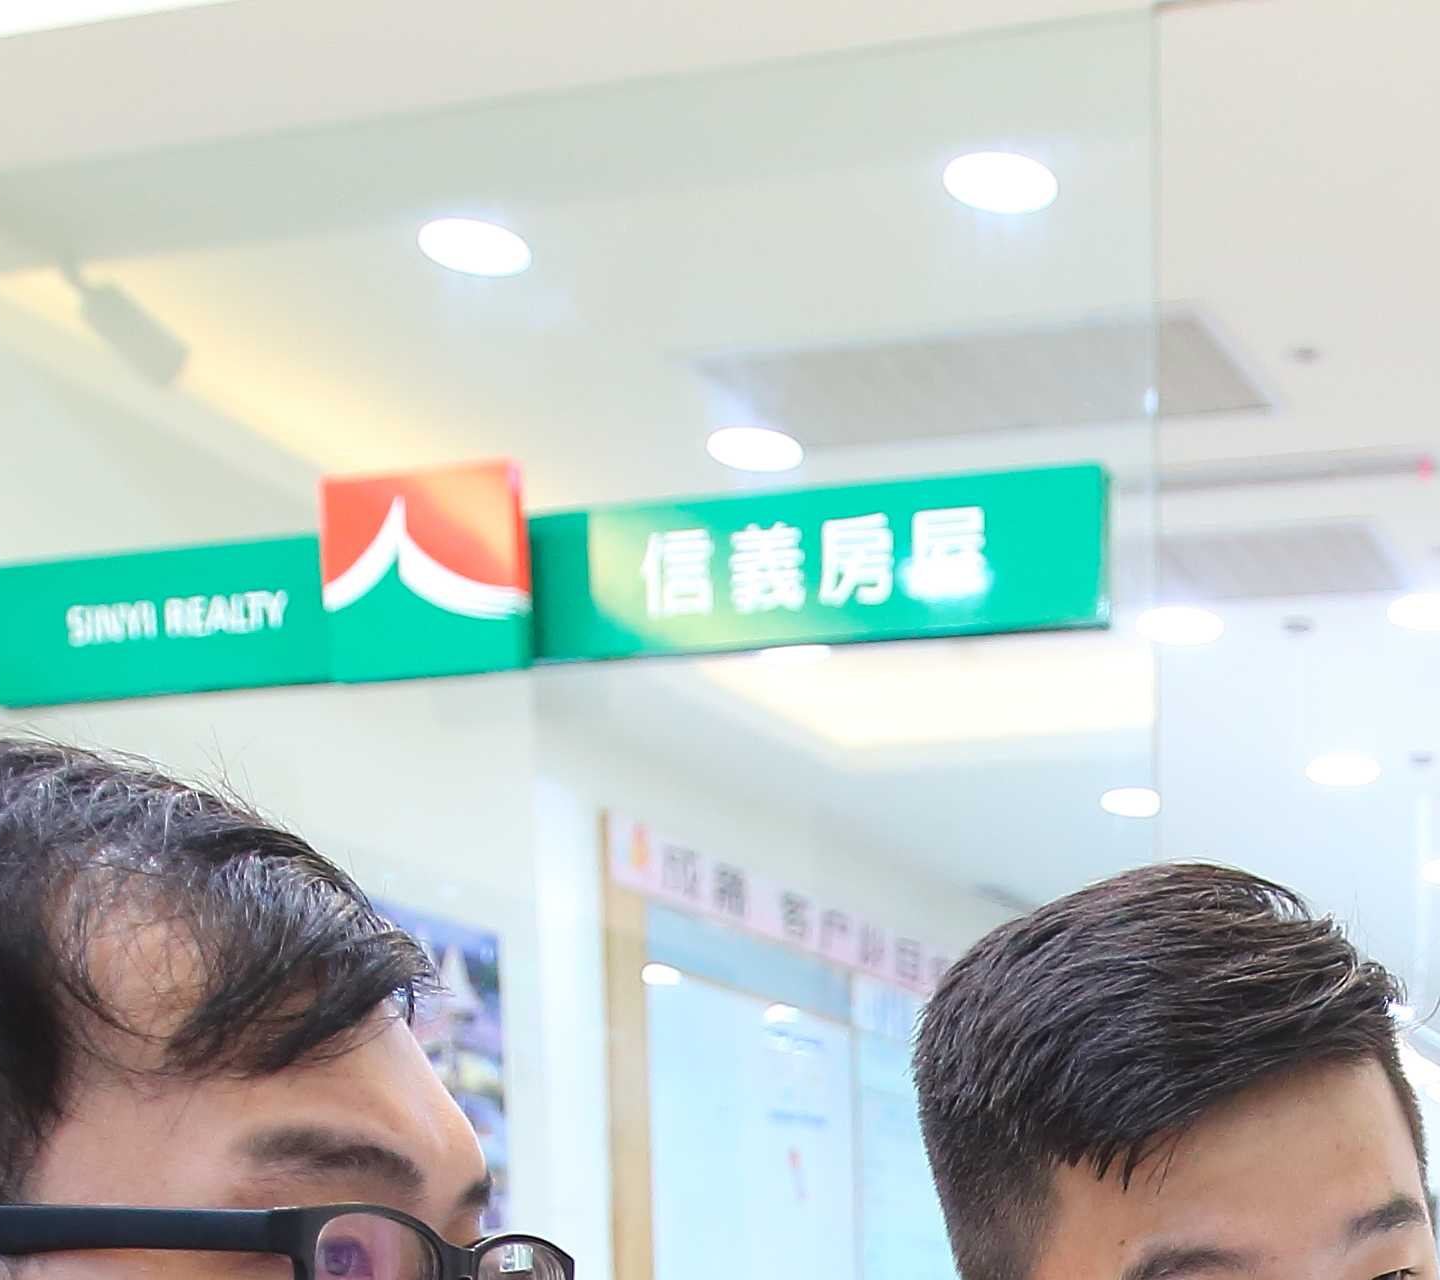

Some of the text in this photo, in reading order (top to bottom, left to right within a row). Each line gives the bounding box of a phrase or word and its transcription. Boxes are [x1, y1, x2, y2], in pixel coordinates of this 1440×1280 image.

[639, 507, 989, 621] 信義房屋
[67, 590, 288, 647] SINYI REALTY
